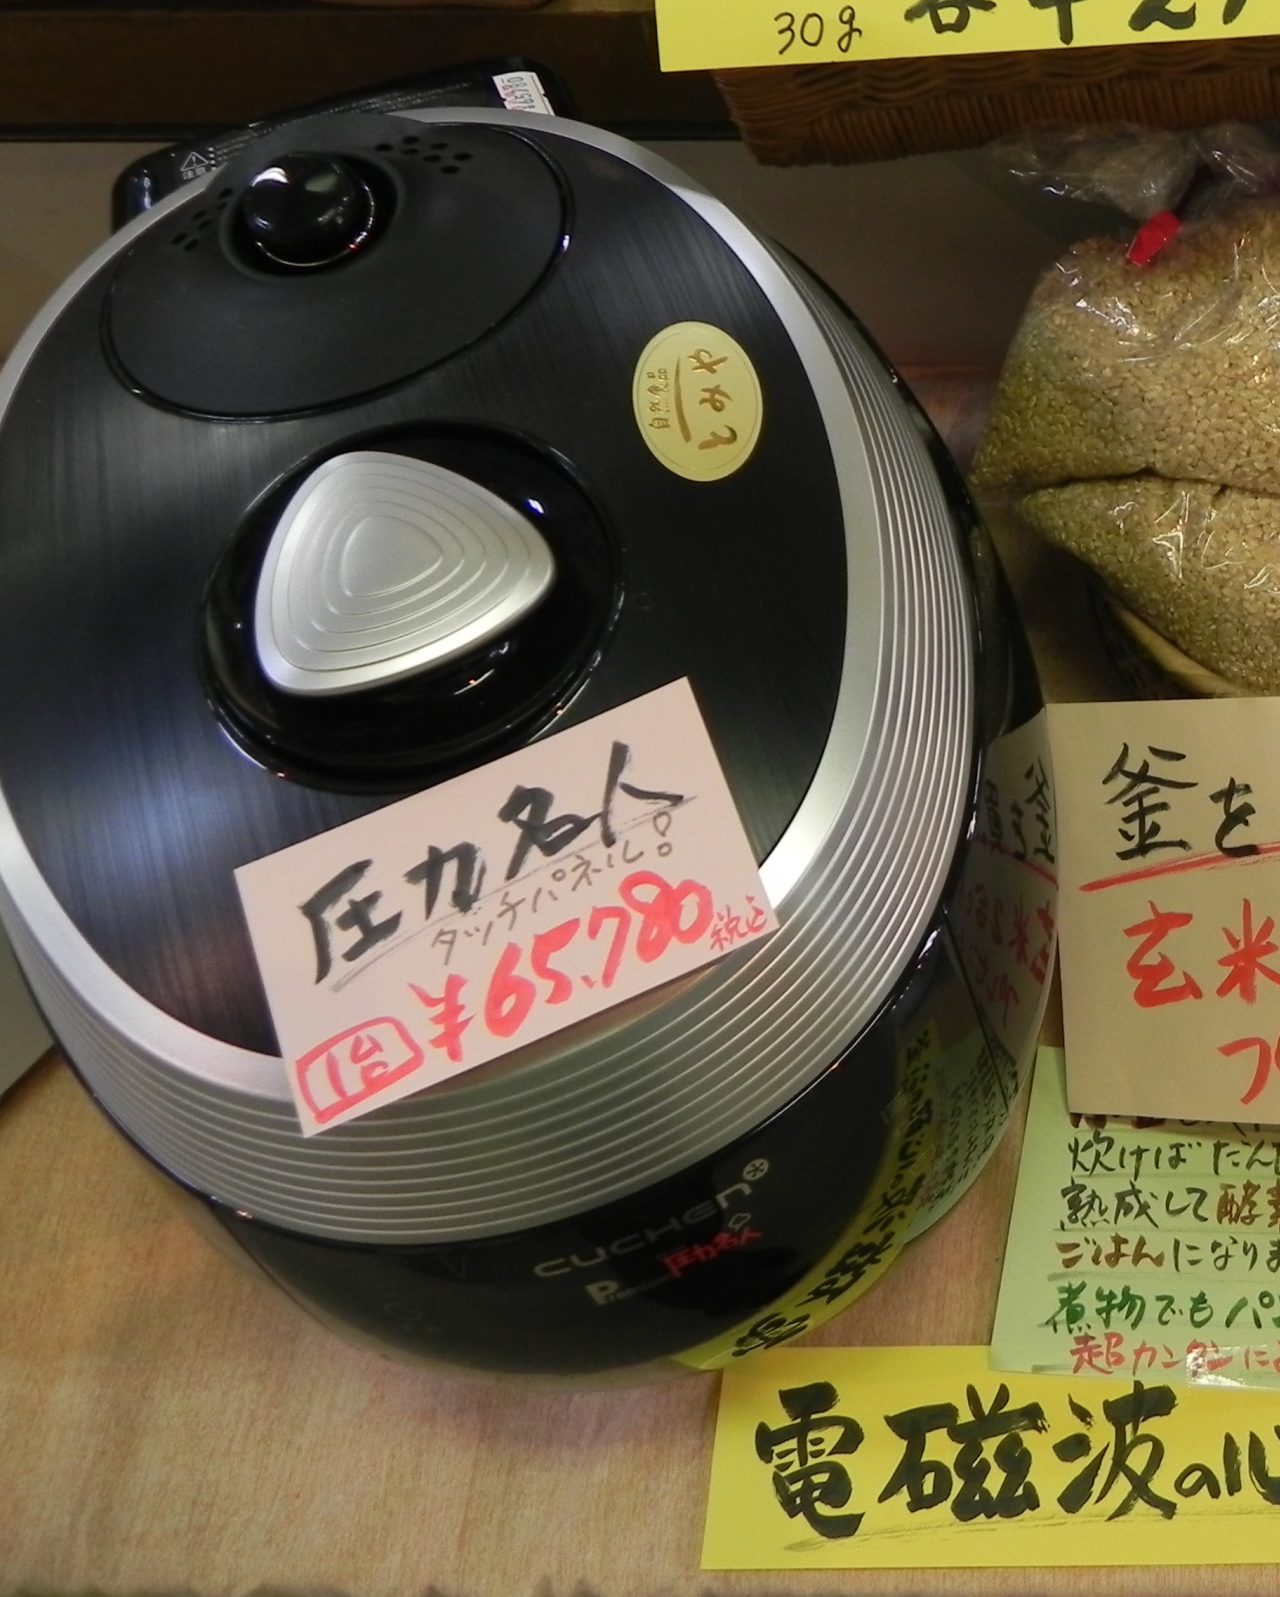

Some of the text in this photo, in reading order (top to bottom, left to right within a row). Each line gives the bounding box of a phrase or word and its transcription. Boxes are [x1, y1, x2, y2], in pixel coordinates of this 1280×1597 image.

[297, 740, 685, 985] 圧力名人
[711, 894, 769, 953] 税込
